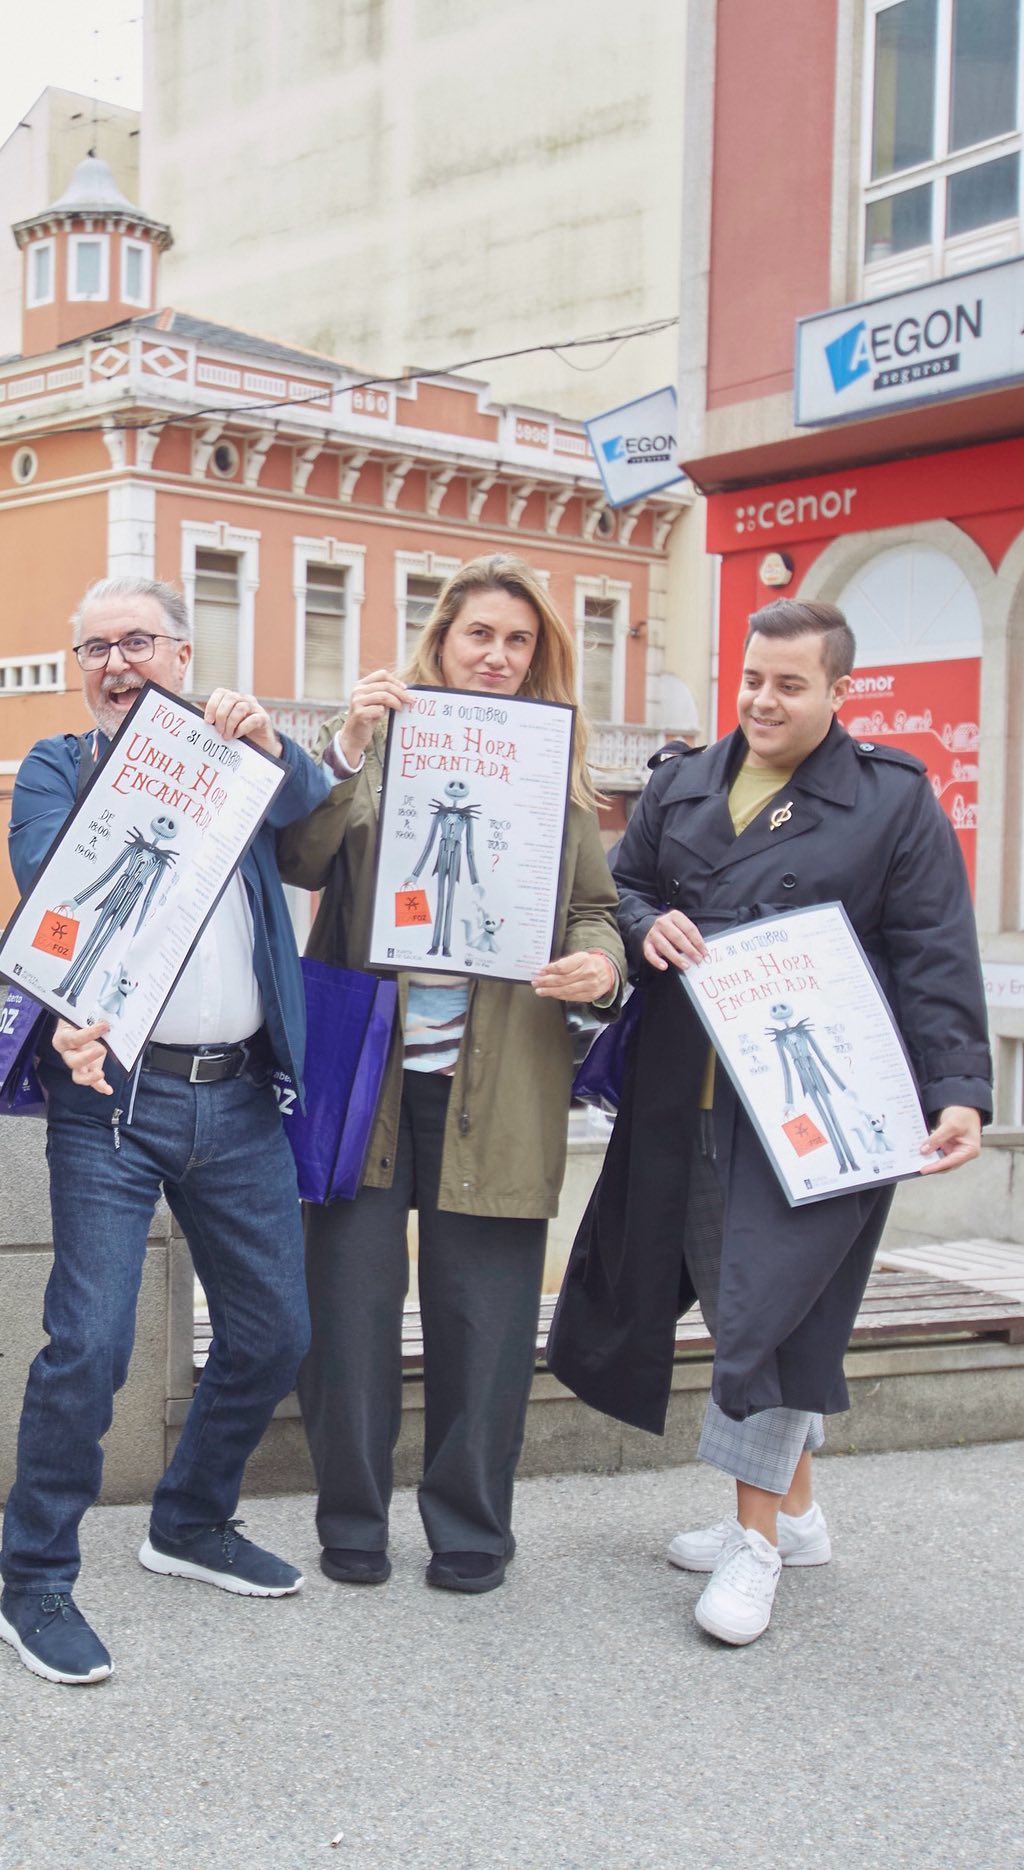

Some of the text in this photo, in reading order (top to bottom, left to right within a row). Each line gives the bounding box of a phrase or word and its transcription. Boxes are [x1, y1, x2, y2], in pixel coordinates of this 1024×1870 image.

[849, 299, 983, 373] AEGON
[881, 358, 953, 386] seguros
[757, 487, 857, 529] cenor
[150, 704, 186, 738] FOZ
[186, 729, 202, 746] 31
[442, 704, 453, 716] 31
[458, 705, 508, 725] OUTUBRO
[125, 732, 186, 785] UNHA
[400, 725, 520, 763] UNHA HORA
[400, 753, 514, 785] ENCANTADA
[97, 808, 116, 828] DE
[491, 853, 500, 873] ?
[740, 929, 788, 953] OUTUBRO
[716, 975, 823, 1021] ENCANTADA
